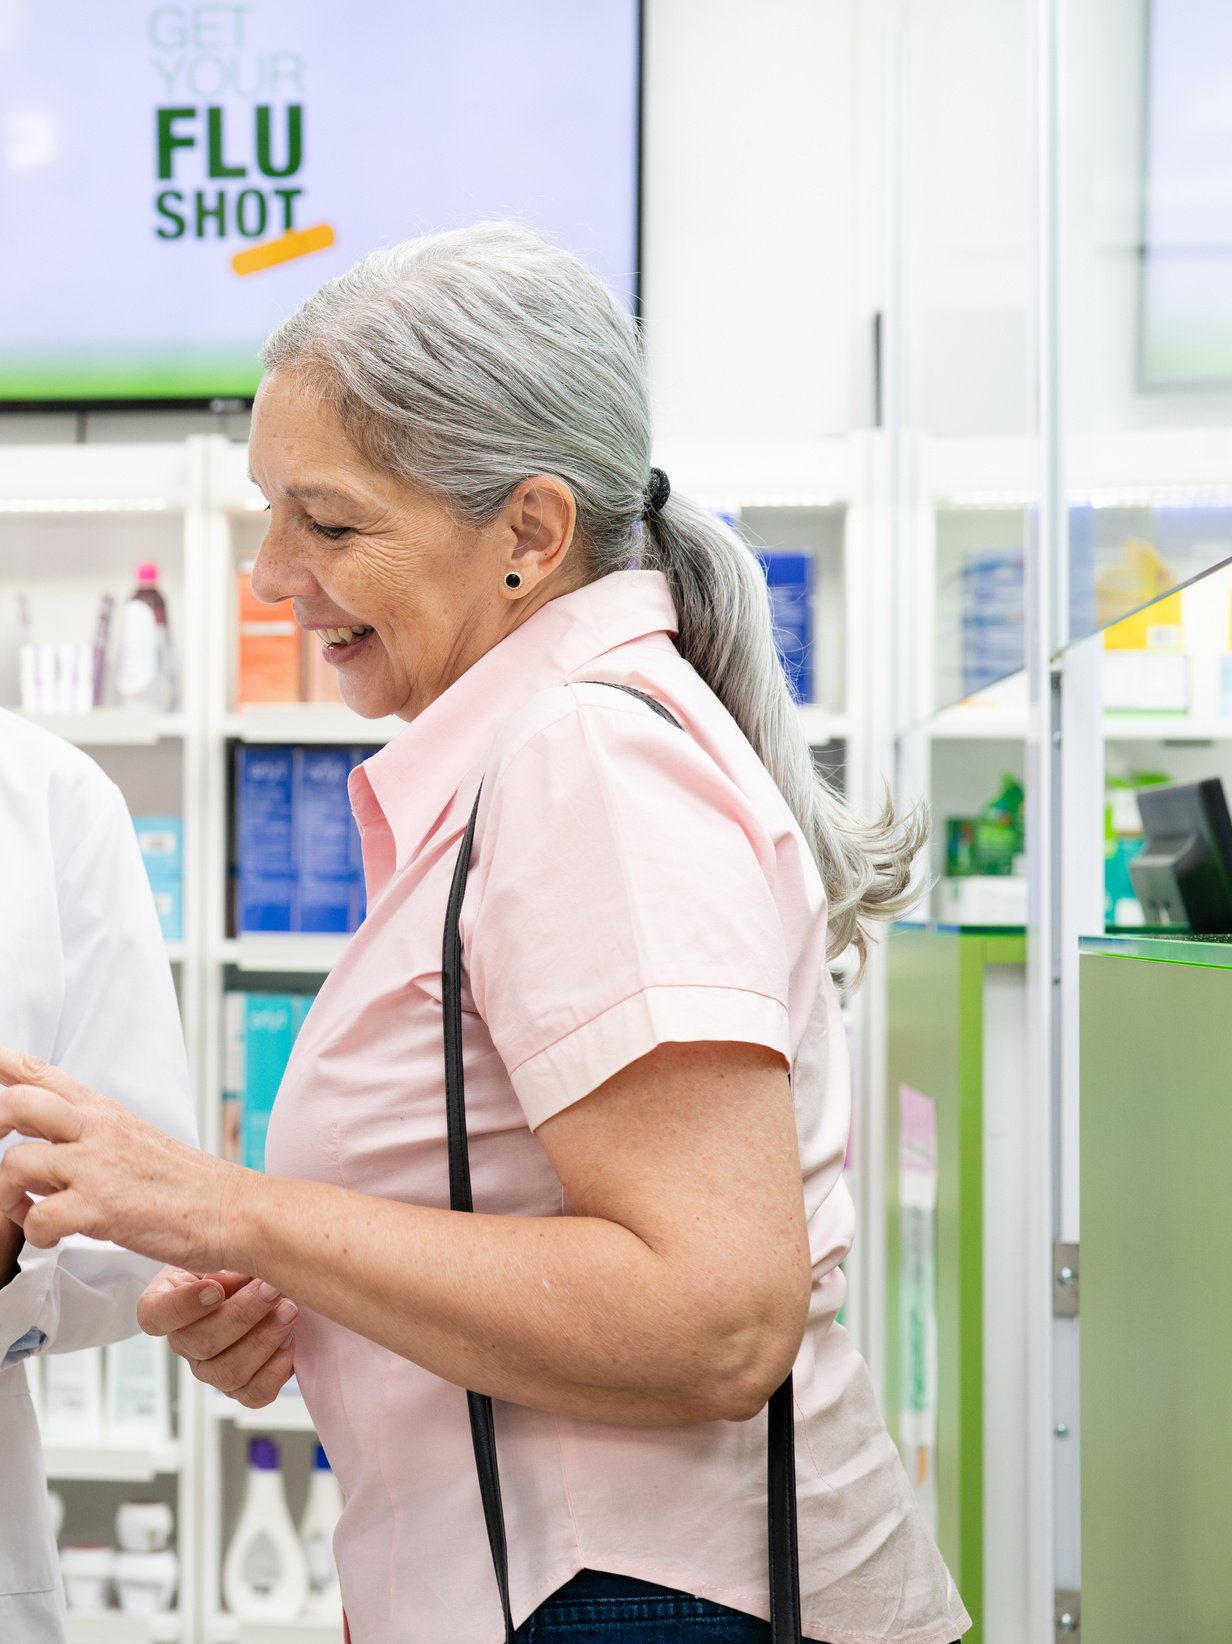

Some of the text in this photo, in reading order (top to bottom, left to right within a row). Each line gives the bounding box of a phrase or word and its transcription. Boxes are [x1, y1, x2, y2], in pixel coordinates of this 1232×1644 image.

[147, 3, 252, 50] GET
[152, 52, 306, 98] YOUR
[155, 104, 304, 180] FLU
[155, 188, 304, 239] SHOT
